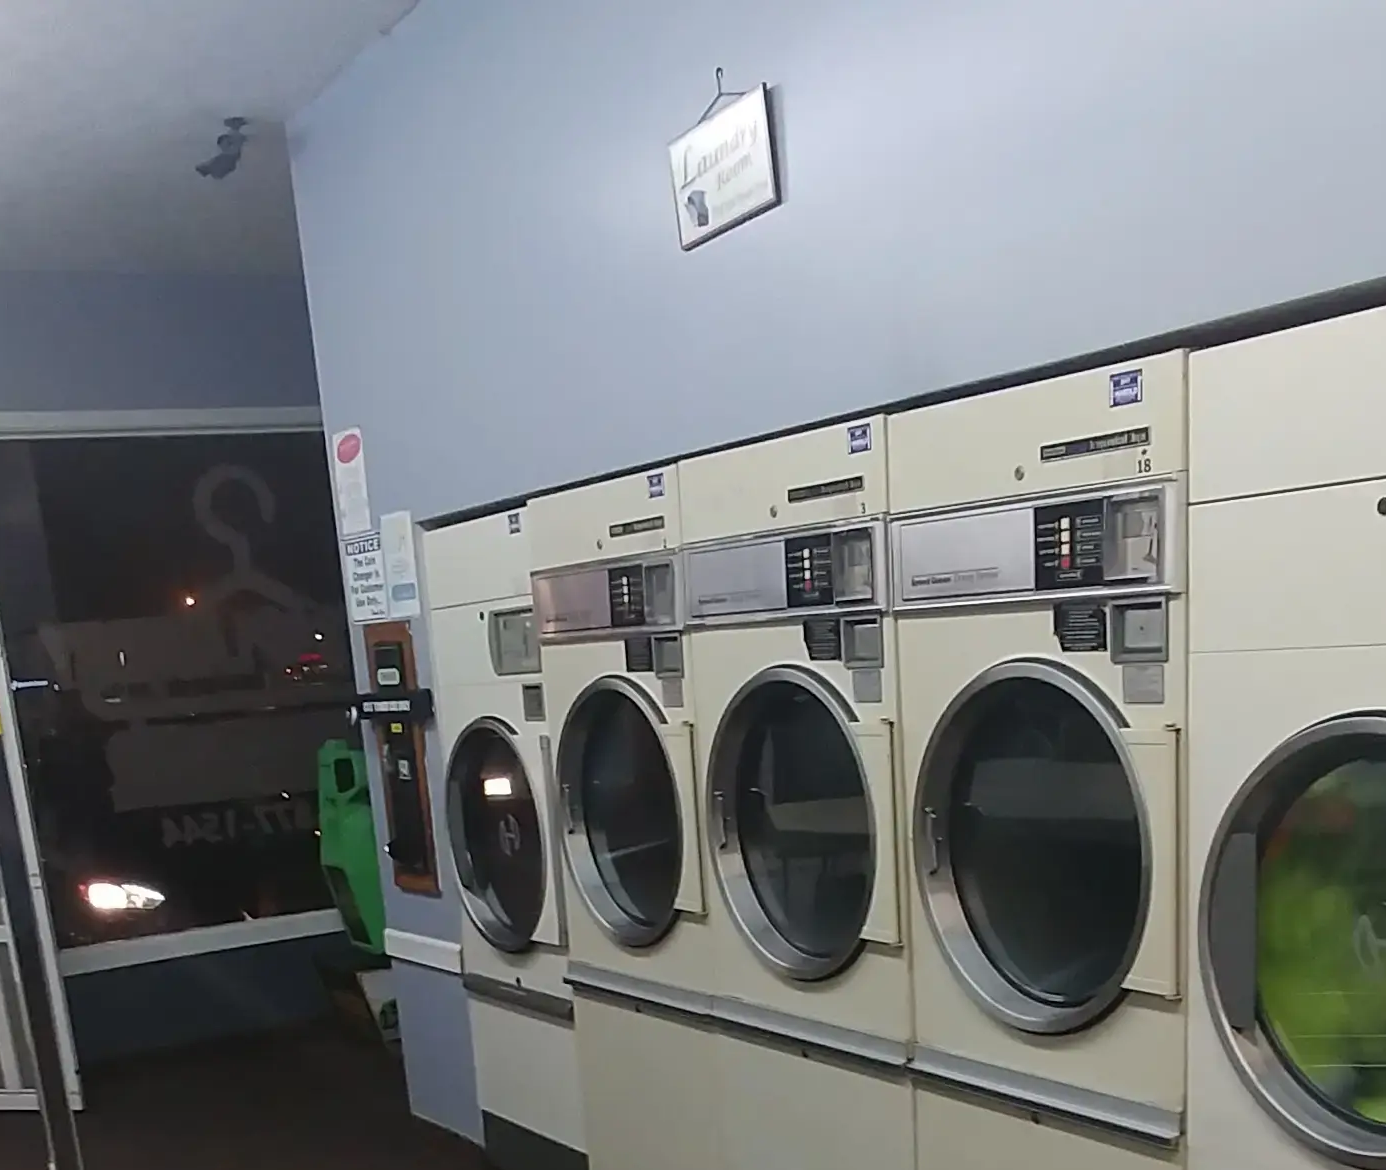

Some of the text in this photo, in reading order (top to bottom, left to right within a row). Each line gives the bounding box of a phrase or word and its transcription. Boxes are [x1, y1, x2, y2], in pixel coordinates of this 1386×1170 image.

[679, 119, 757, 190] Laundry
[1136, 458, 1152, 474] 18
[346, 538, 380, 555] NOTICE
